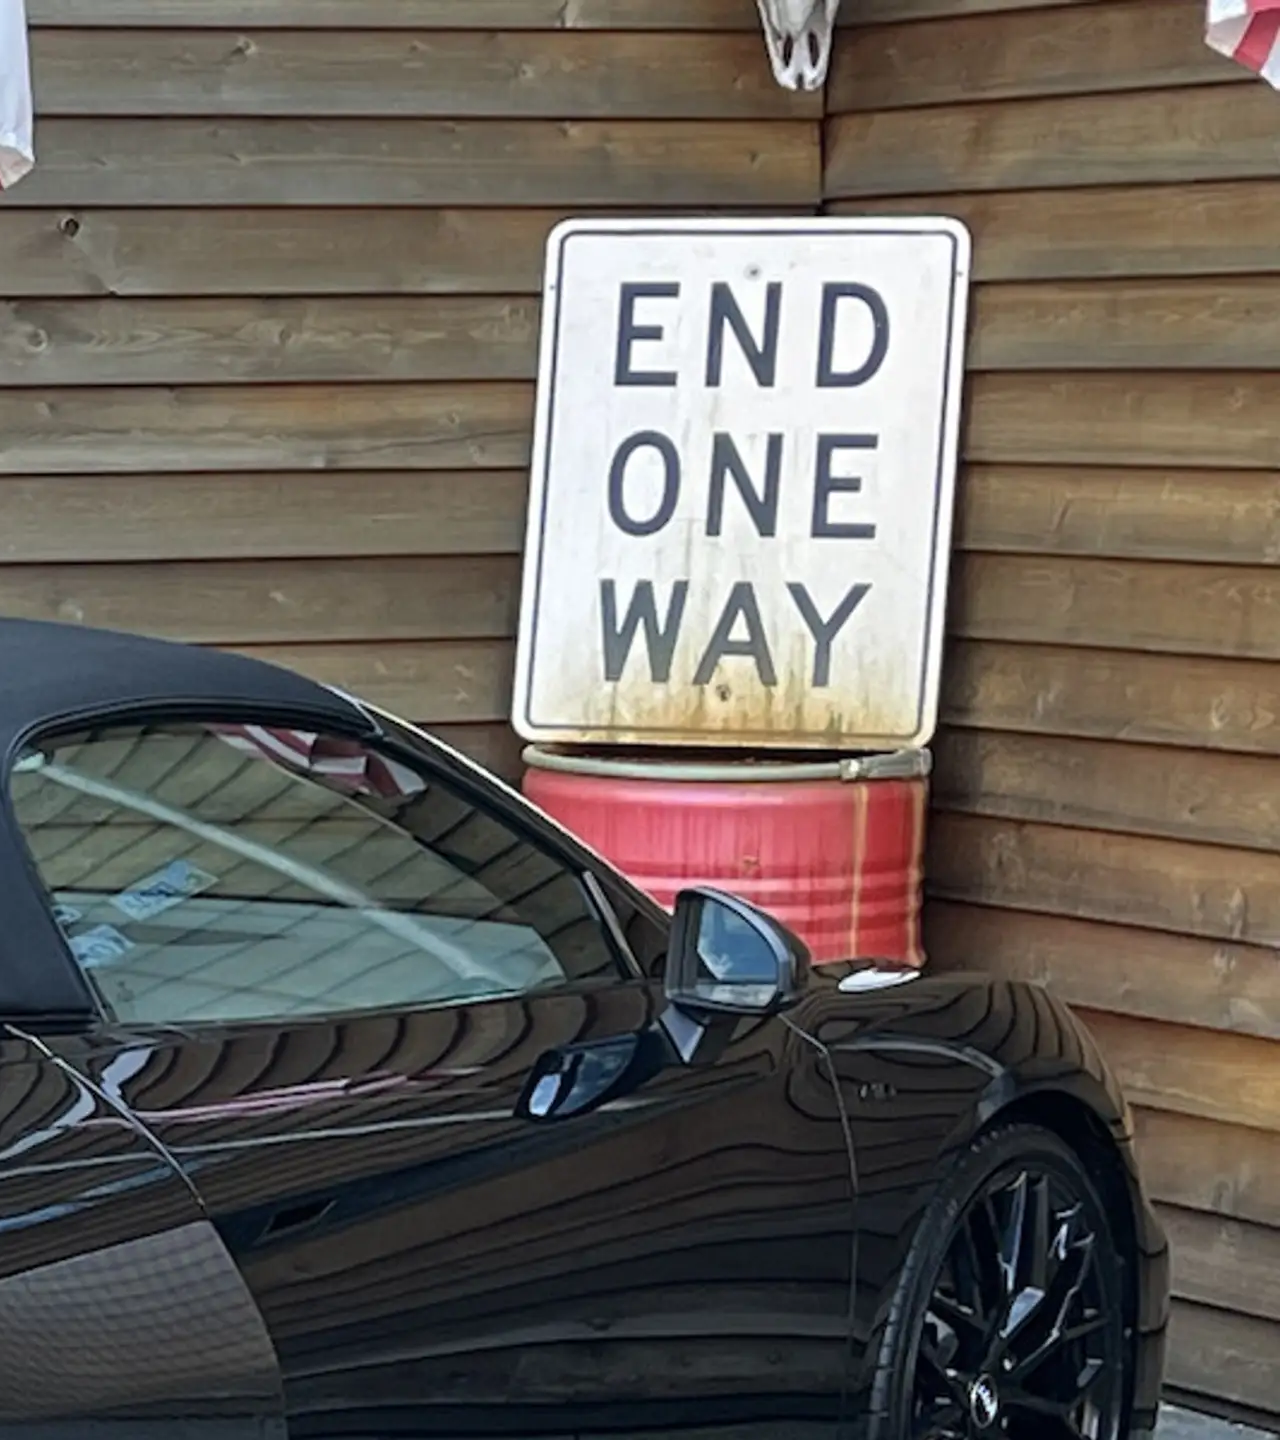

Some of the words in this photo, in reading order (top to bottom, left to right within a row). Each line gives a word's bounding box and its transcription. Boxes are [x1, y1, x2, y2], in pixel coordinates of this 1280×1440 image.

[612, 280, 892, 389] END
[605, 428, 881, 540] ONE
[598, 577, 873, 688] WAY
